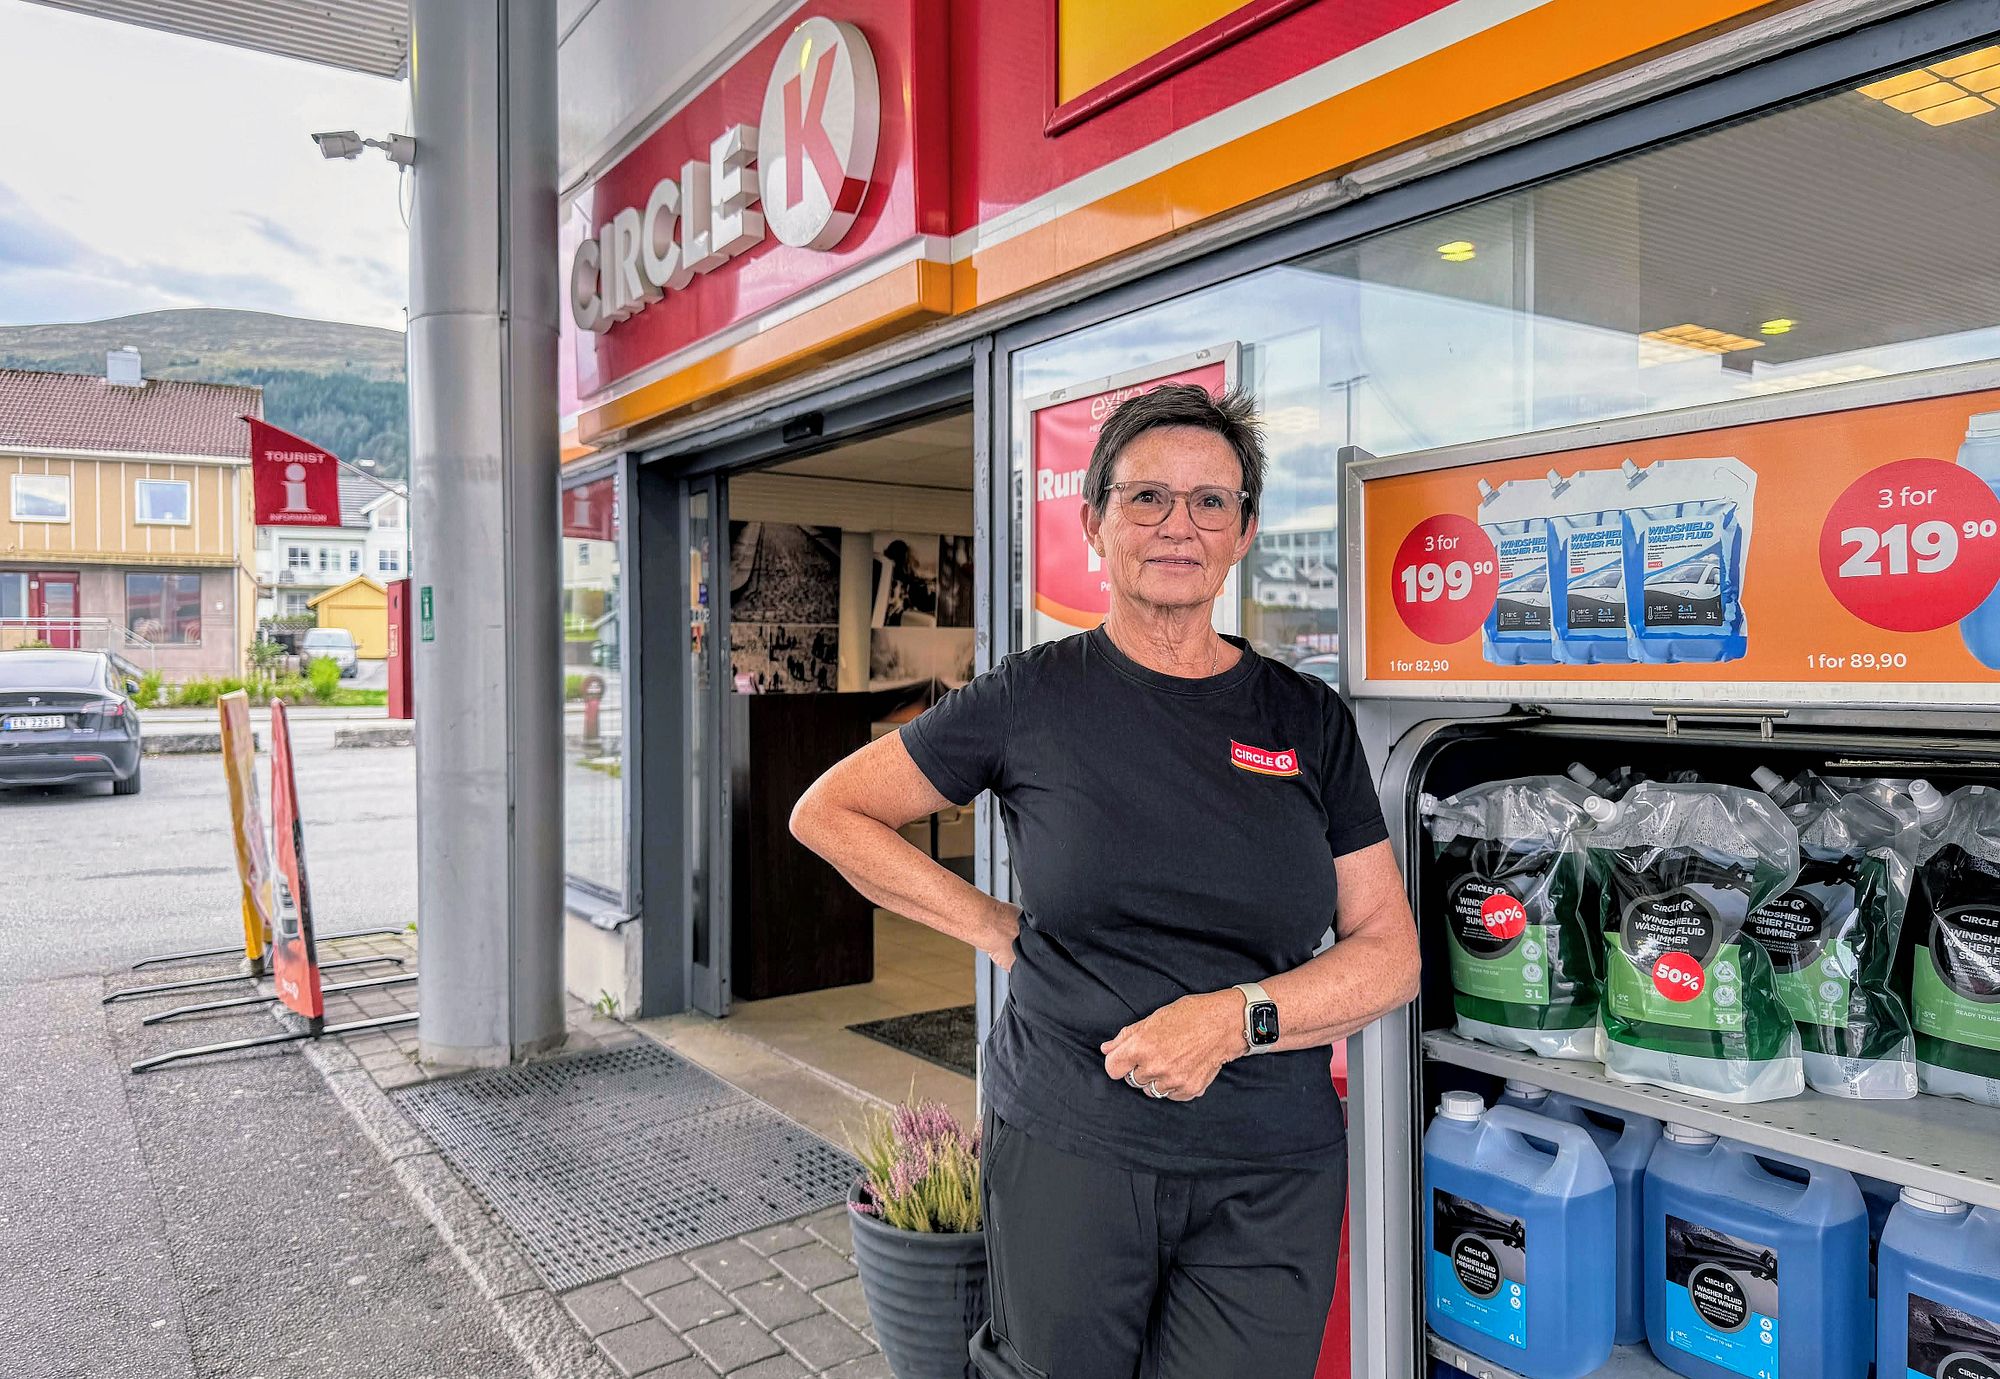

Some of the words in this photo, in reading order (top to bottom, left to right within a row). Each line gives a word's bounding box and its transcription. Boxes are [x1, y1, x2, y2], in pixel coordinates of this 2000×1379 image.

[571, 124, 765, 334] CIRCLE
[264, 450, 325, 464] TOURIST
[1878, 488, 1893, 509] 3
[1899, 486, 1938, 507] for
[269, 513, 328, 522] INFORMATION
[1648, 521, 1714, 535] WINDSHIELD
[1425, 536, 1434, 552] 3
[1437, 534, 1460, 550] for
[1648, 533, 1684, 543] WASHER
[1685, 531, 1714, 540] FLUID
[1839, 520, 1959, 578] 219
[1962, 519, 1997, 539] 90
[1401, 560, 1473, 603] 199
[1474, 561, 1494, 576] 90
[1390, 661, 1395, 671] 1
[1397, 660, 1413, 672] for
[1415, 660, 1449, 673] 82,90
[1807, 654, 1815, 669] 1
[1818, 653, 1846, 669] for
[1850, 653, 1907, 671] 89,90
[1235, 748, 1274, 767] CIRCLE
[1466, 883, 1494, 895] CIRCLE
[1652, 903, 1680, 913] CIRCLE
[1484, 905, 1523, 928] 50%
[1641, 913, 1701, 926] WINDSHIELD
[1960, 914, 1999, 928] CIRCLE
[1634, 921, 1676, 935] WASHER
[1676, 926, 1706, 937] FLUID
[1756, 926, 1797, 939] SUMMER
[1784, 922, 1814, 932] FLUID
[1647, 932, 1689, 945] SUMMER
[1656, 964, 1700, 991] 50%
[1956, 1009, 1976, 1018] READY
[1464, 1246, 1481, 1257] CIRCLE
[1456, 1259, 1475, 1272] PREMIX
[1475, 1267, 1497, 1280] WINTER
[1457, 1253, 1480, 1267] WASHER
[1480, 1262, 1496, 1273] FLUID
[1703, 1276, 1725, 1289] CIRCLE
[1694, 1290, 1717, 1304] PREMIX
[1717, 1298, 1744, 1313] WINTER
[1696, 1284, 1723, 1299] WASHER
[1723, 1294, 1743, 1305] FLUID
[1509, 1333, 1515, 1341] 4
